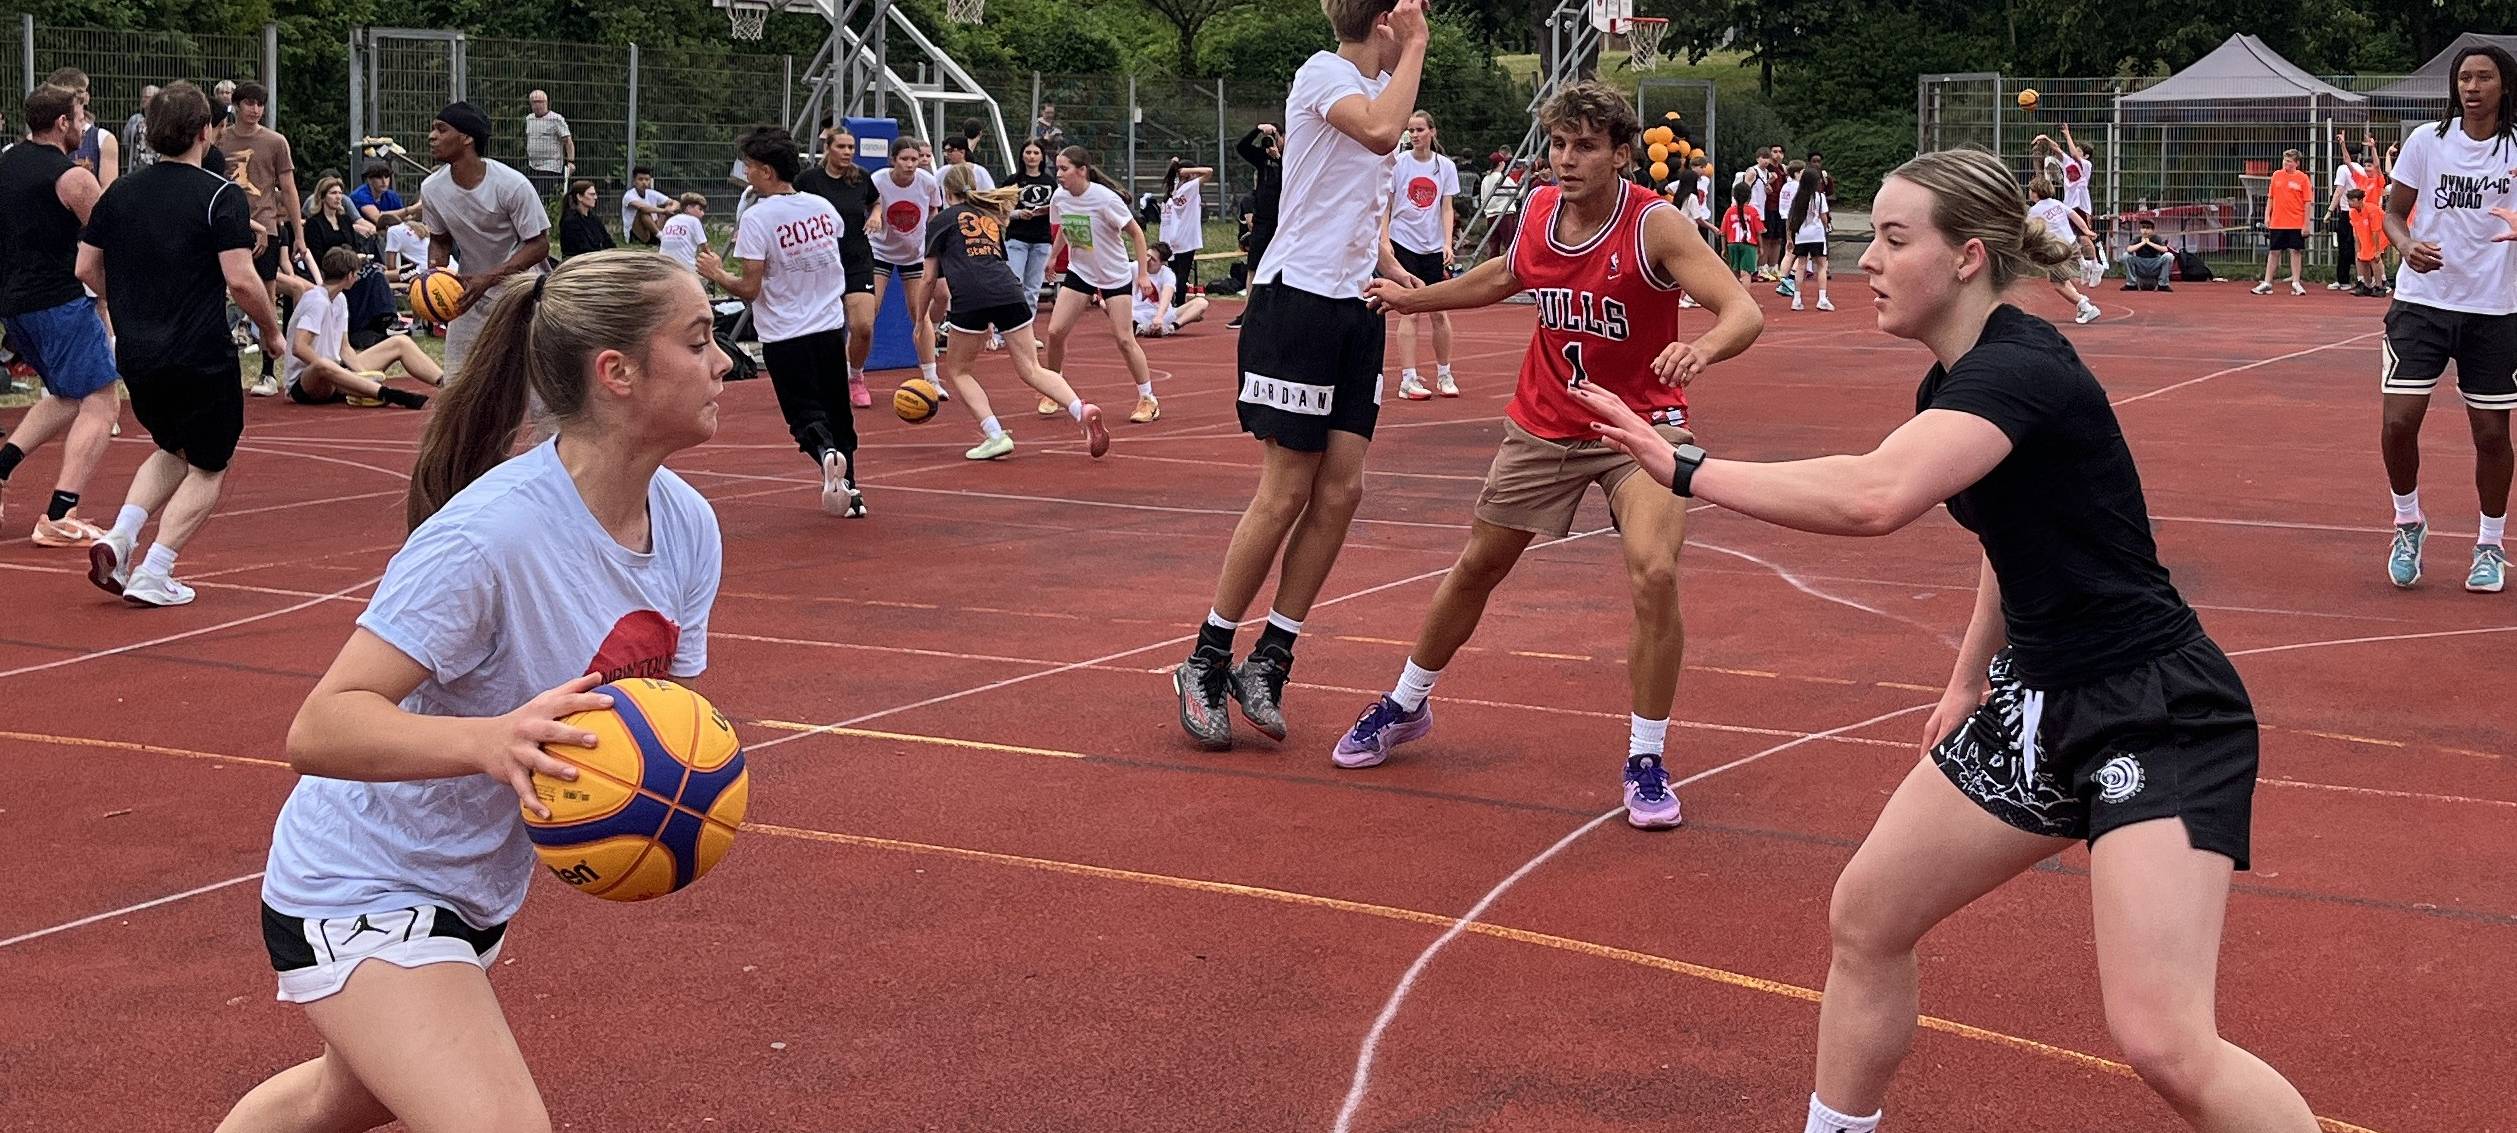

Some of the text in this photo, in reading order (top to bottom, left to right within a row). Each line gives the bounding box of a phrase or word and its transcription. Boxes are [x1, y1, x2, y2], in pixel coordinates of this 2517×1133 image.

[2434, 187, 2483, 210] SQUAD
[663, 224, 688, 237] 026
[776, 212, 834, 249] 2026
[1562, 341, 1589, 392] 1
[1245, 379, 1328, 410] ORDAN
